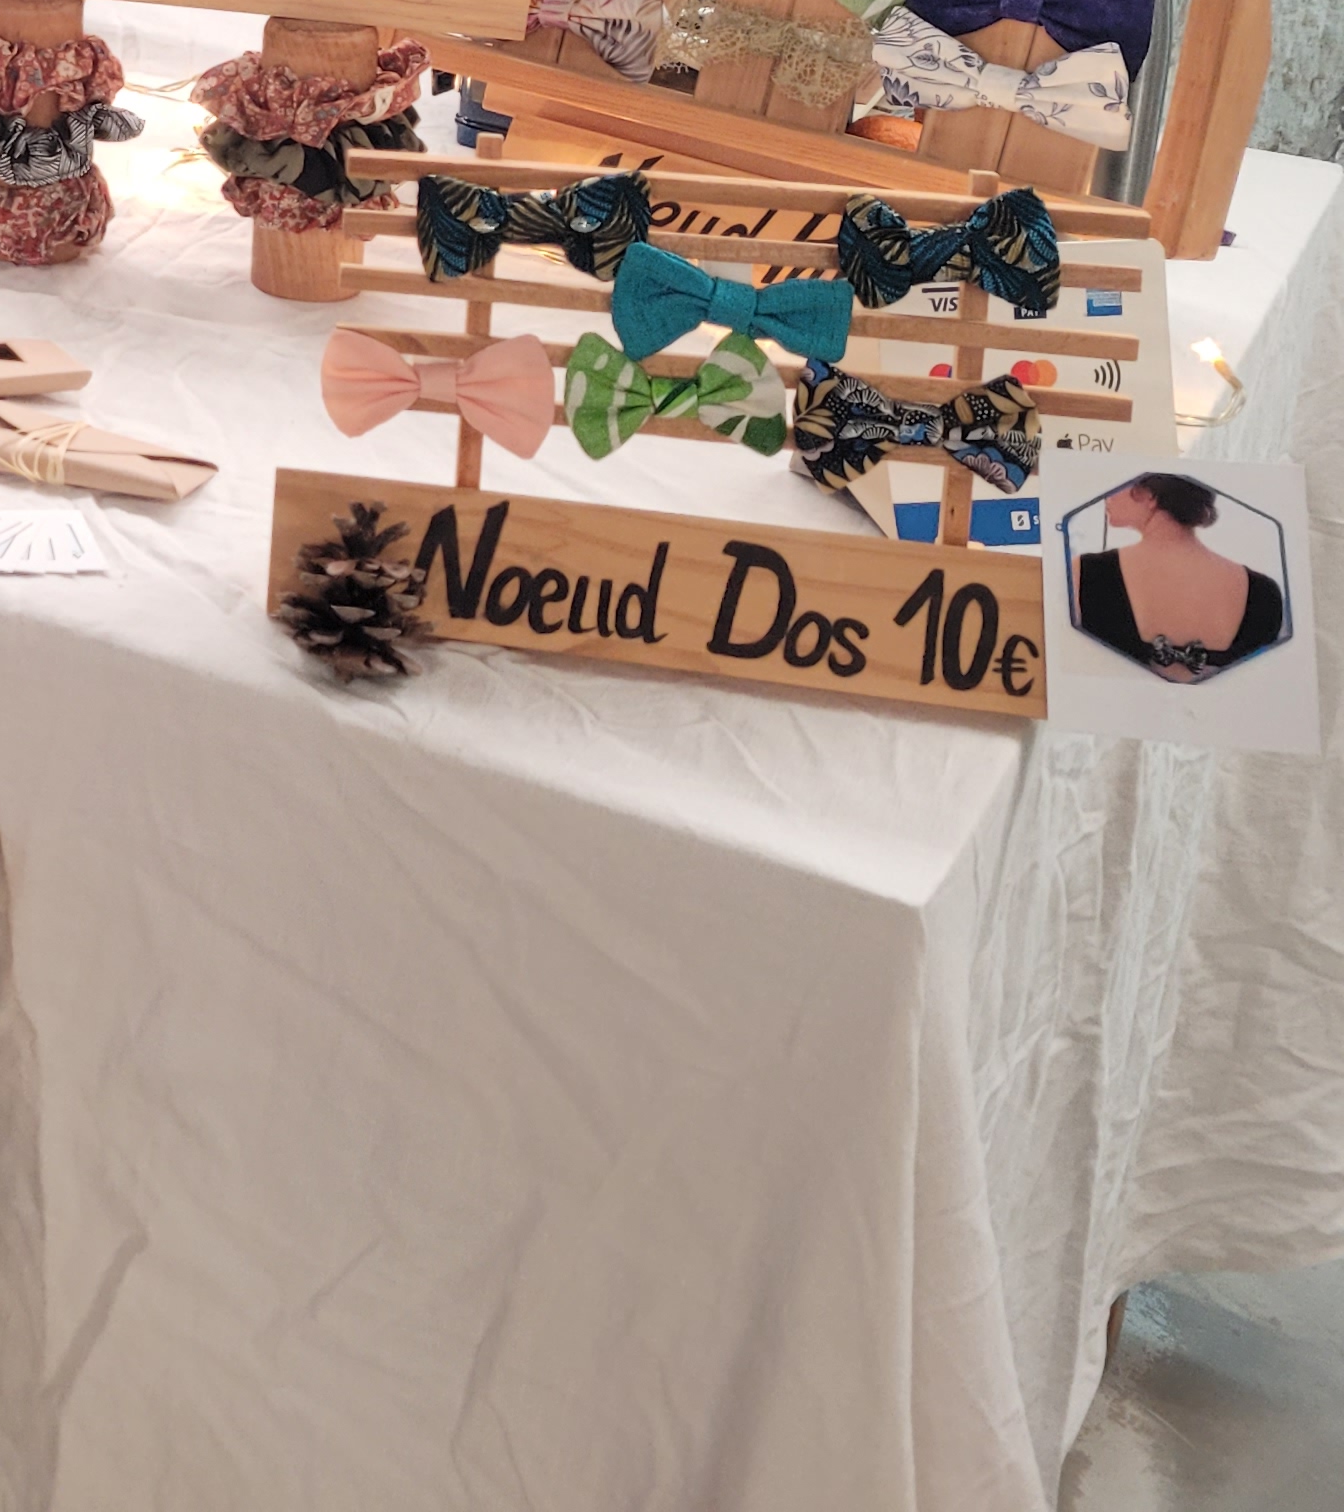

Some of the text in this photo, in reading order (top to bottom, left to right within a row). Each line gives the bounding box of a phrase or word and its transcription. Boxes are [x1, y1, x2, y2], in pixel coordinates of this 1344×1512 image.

[927, 296, 959, 312] VIS
[707, 539, 869, 678] Dos
[892, 568, 1040, 698] 10€
